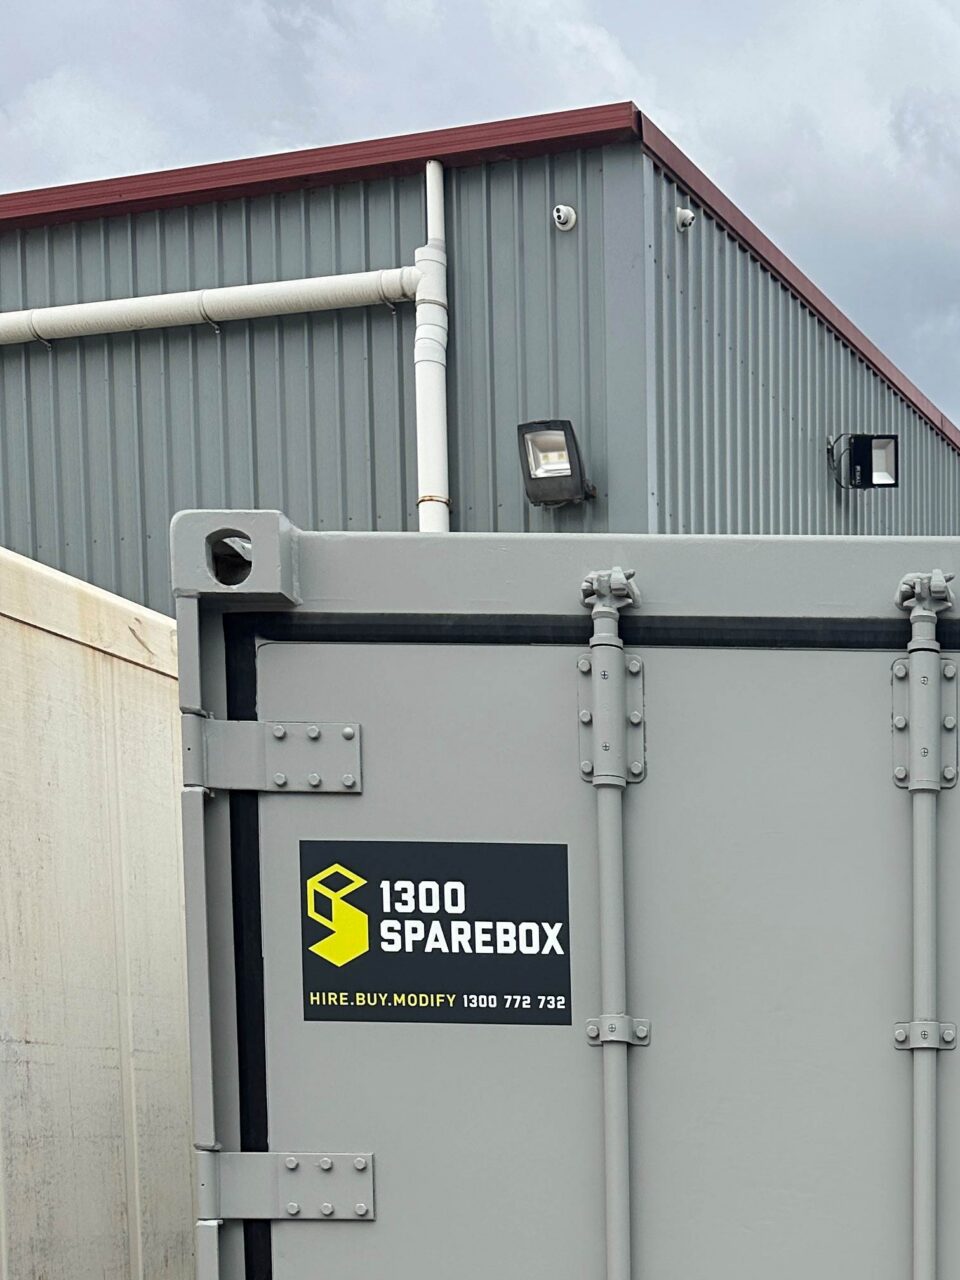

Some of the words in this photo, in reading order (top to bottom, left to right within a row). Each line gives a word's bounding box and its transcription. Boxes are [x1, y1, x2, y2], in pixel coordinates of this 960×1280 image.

[379, 880, 465, 914] 1300
[379, 919, 565, 955] SPAREBOX
[309, 991, 457, 1008] HIRE.BUY.MODIFY
[462, 994, 498, 1008] 1300
[503, 994, 531, 1009] 772
[537, 995, 566, 1009] 732
